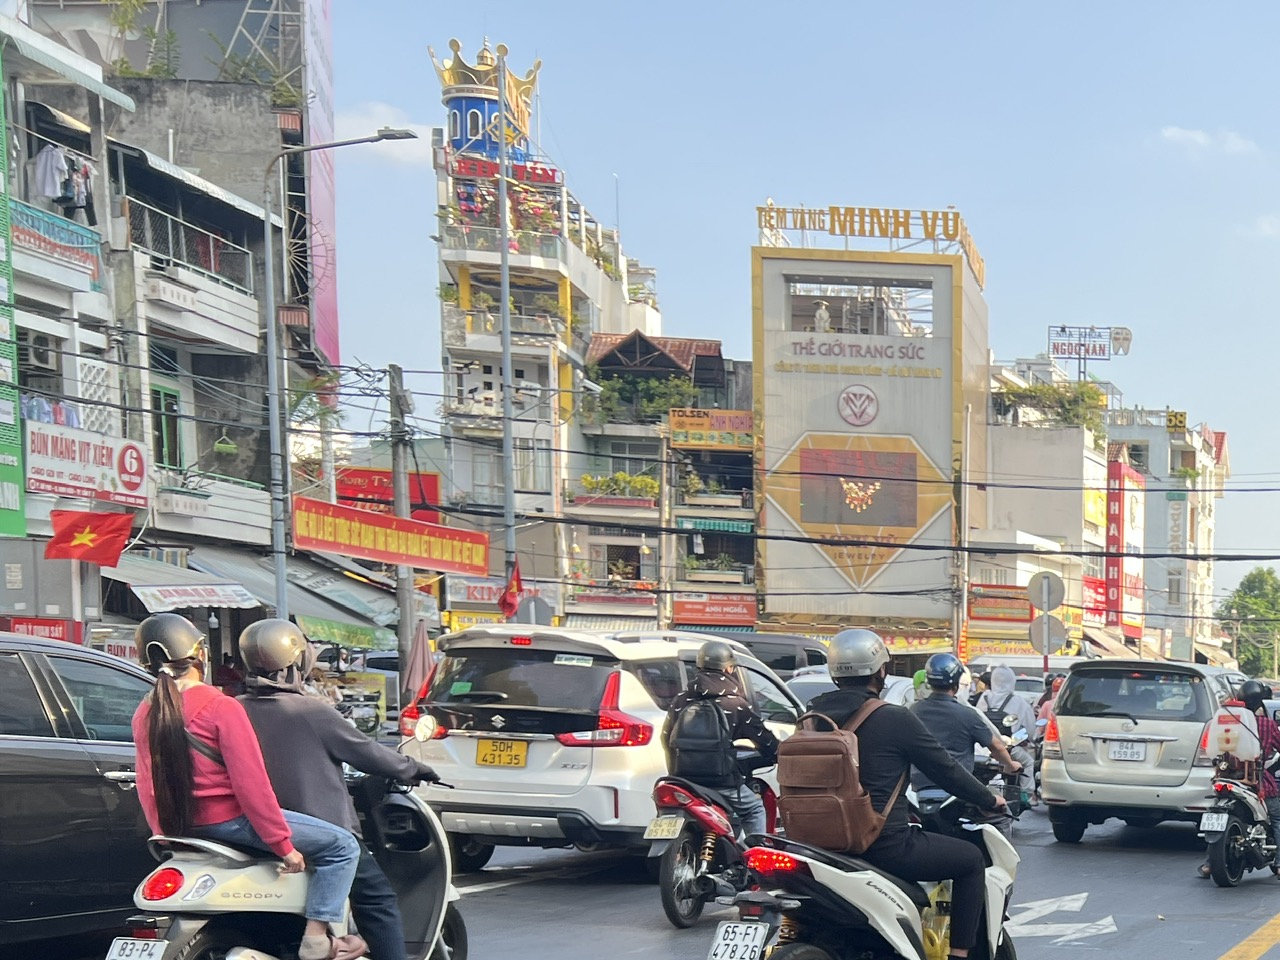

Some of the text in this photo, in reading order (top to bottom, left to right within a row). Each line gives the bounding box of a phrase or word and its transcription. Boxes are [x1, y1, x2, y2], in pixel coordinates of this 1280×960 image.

[829, 205, 910, 238] MINH
[921, 205, 960, 241] VŨ
[792, 337, 925, 360] THẾ GIỚI TRANG SỨC
[671, 409, 709, 418] TOLSEN
[1167, 412, 1185, 427] 58
[124, 448, 138, 473] 6
[466, 585, 499, 600] KIM
[491, 741, 513, 752] 50H
[481, 754, 520, 765] 431.35
[723, 925, 758, 942] 65-F1
[118, 942, 154, 959] 83-P4
[713, 944, 758, 960] 478.26
